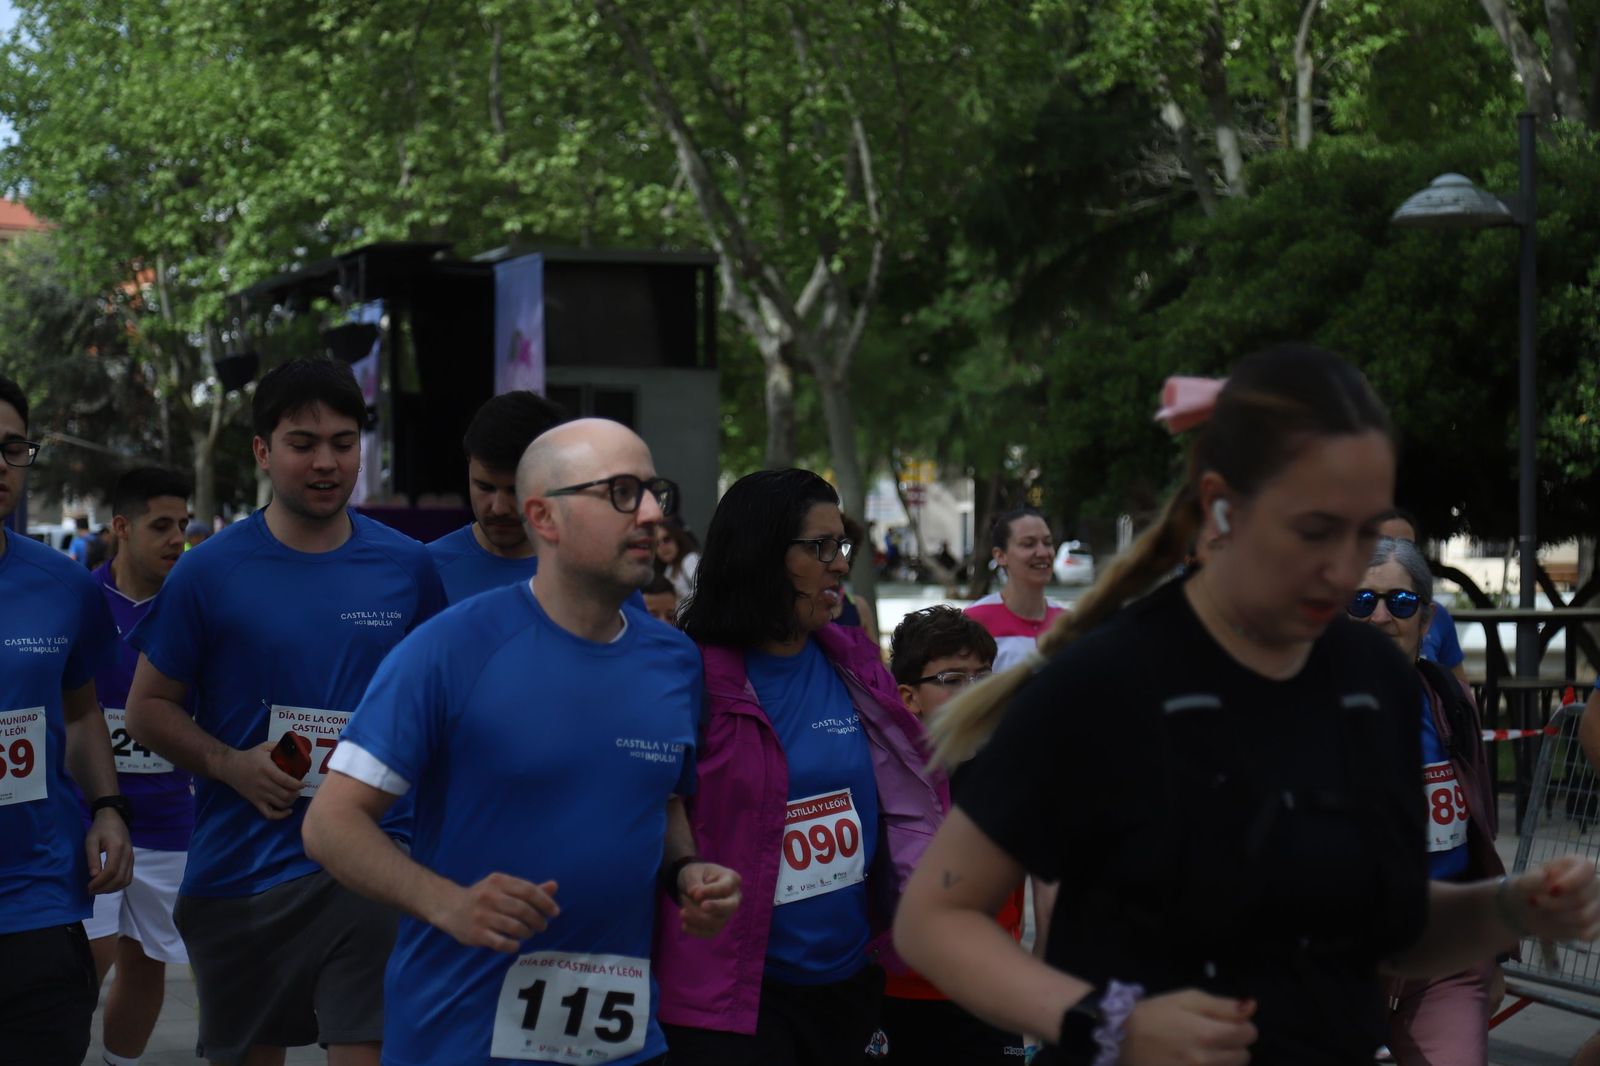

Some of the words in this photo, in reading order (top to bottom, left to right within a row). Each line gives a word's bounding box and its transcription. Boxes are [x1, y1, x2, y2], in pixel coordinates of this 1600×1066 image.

[340, 611, 378, 620] CASTILLA
[380, 611, 385, 619] Y
[386, 609, 402, 619] LEÓN
[4, 637, 44, 646] CASTILLA
[46, 637, 52, 646] Y
[278, 711, 296, 721] DÍA
[297, 713, 311, 722] DE
[313, 715, 325, 723] LA
[5, 725, 27, 737] LEÓN
[292, 723, 335, 735] CASTILLA
[615, 738, 660, 751] CASTILLA
[662, 742, 669, 753] Y
[818, 803, 825, 812] Y
[825, 796, 847, 810] LEÓN
[782, 817, 859, 871] 090
[519, 957, 538, 967] DÍA
[540, 959, 555, 967] DE
[558, 960, 606, 974] CASTILLA
[608, 966, 616, 975] Y
[617, 966, 643, 978] LEÓN
[518, 979, 635, 1044] 115
